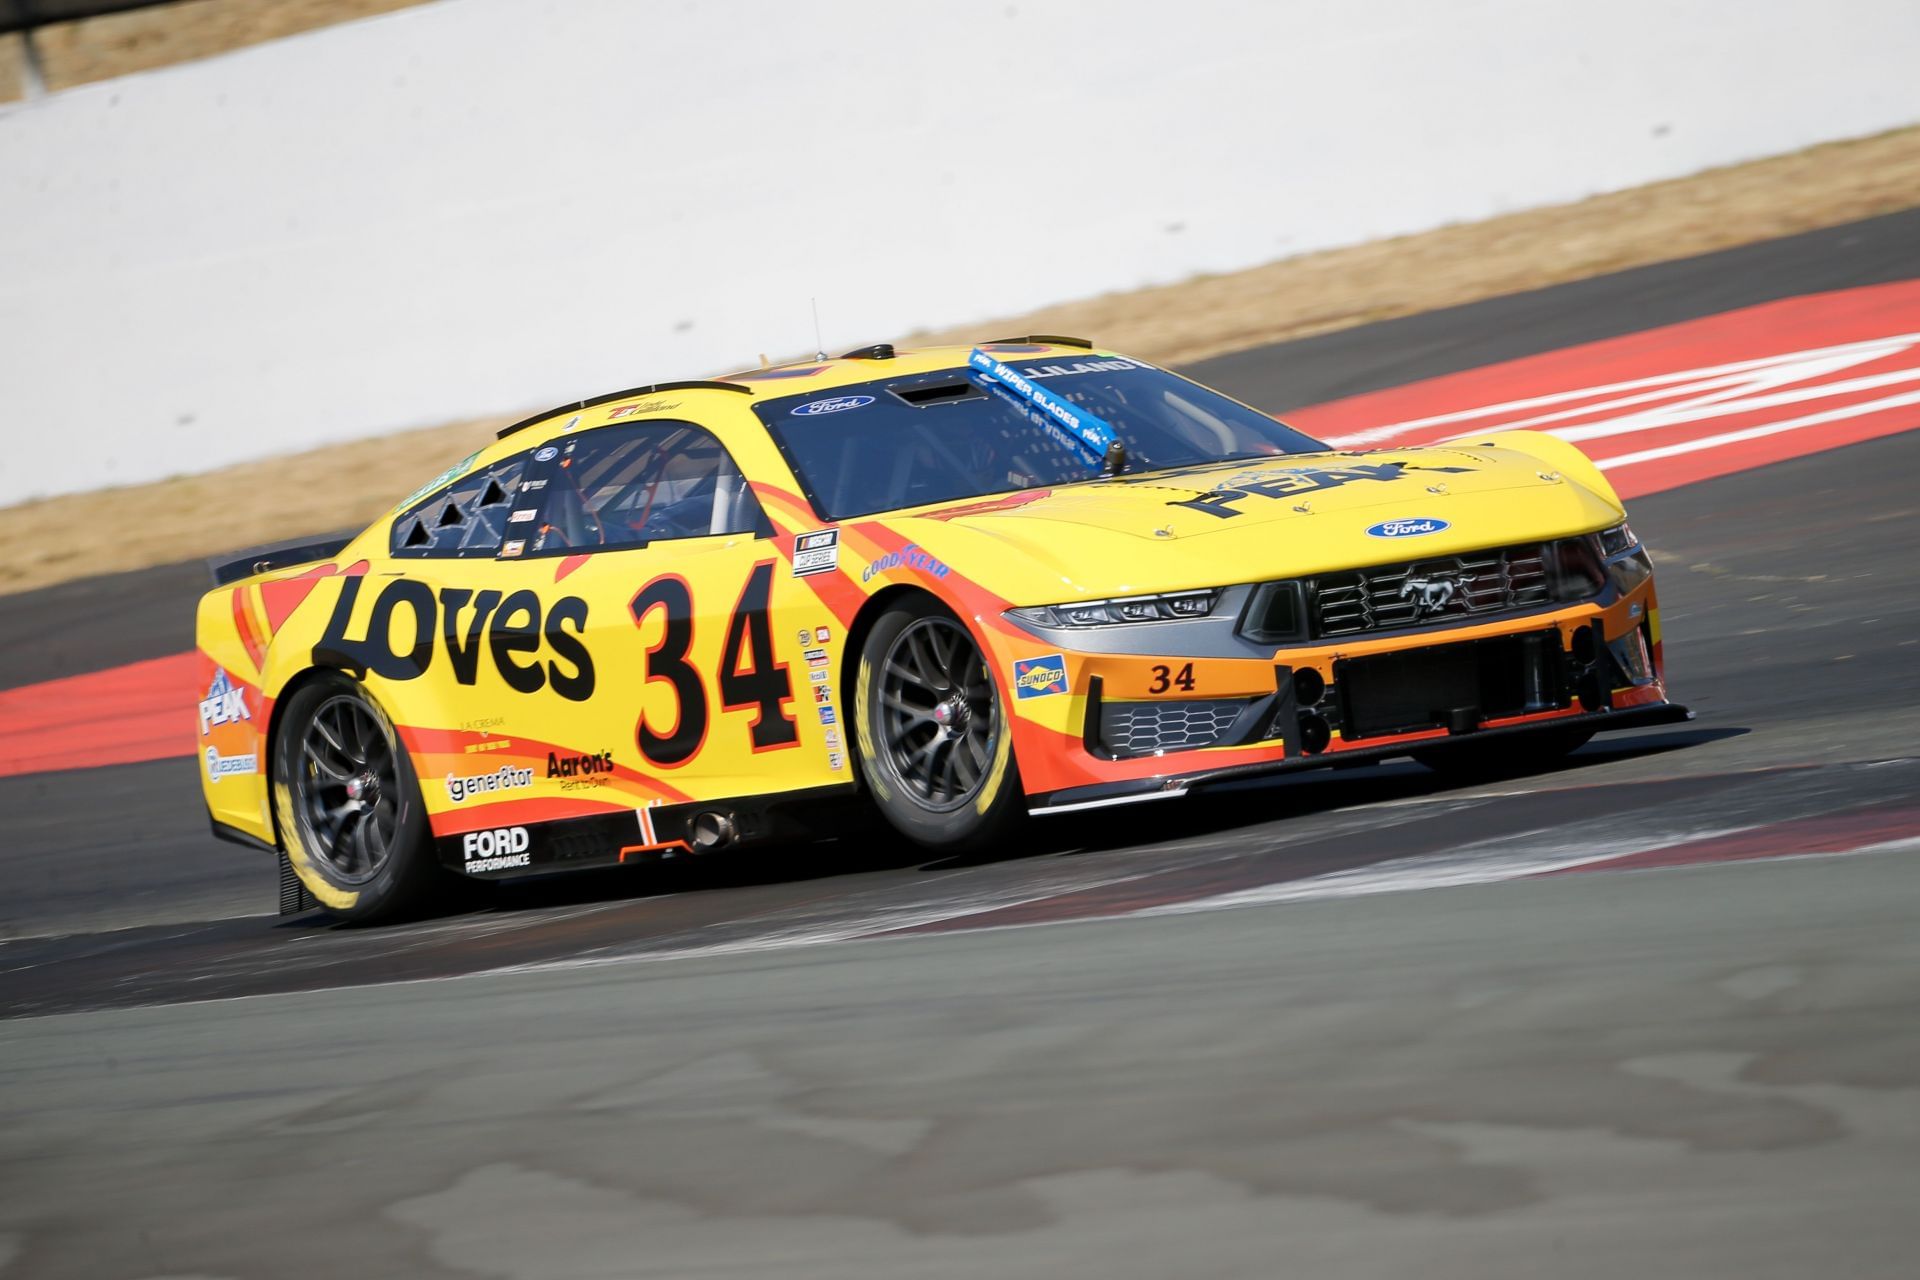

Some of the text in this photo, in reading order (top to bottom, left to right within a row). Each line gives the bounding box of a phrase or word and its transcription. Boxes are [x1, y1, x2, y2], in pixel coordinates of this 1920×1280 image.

[994, 363, 1033, 397] WIPER
[1032, 391, 1081, 430] BLADES
[862, 544, 950, 583] GOODYEAR
[627, 557, 802, 770] 34
[1019, 670, 1063, 687] SUNOCO
[1149, 663, 1196, 695] 34
[198, 687, 252, 736] PEAK
[547, 749, 615, 779] Aaron's
[451, 766, 533, 802] gener8tor
[463, 826, 530, 860] FORD
[465, 852, 531, 874] PERFORMANCE
